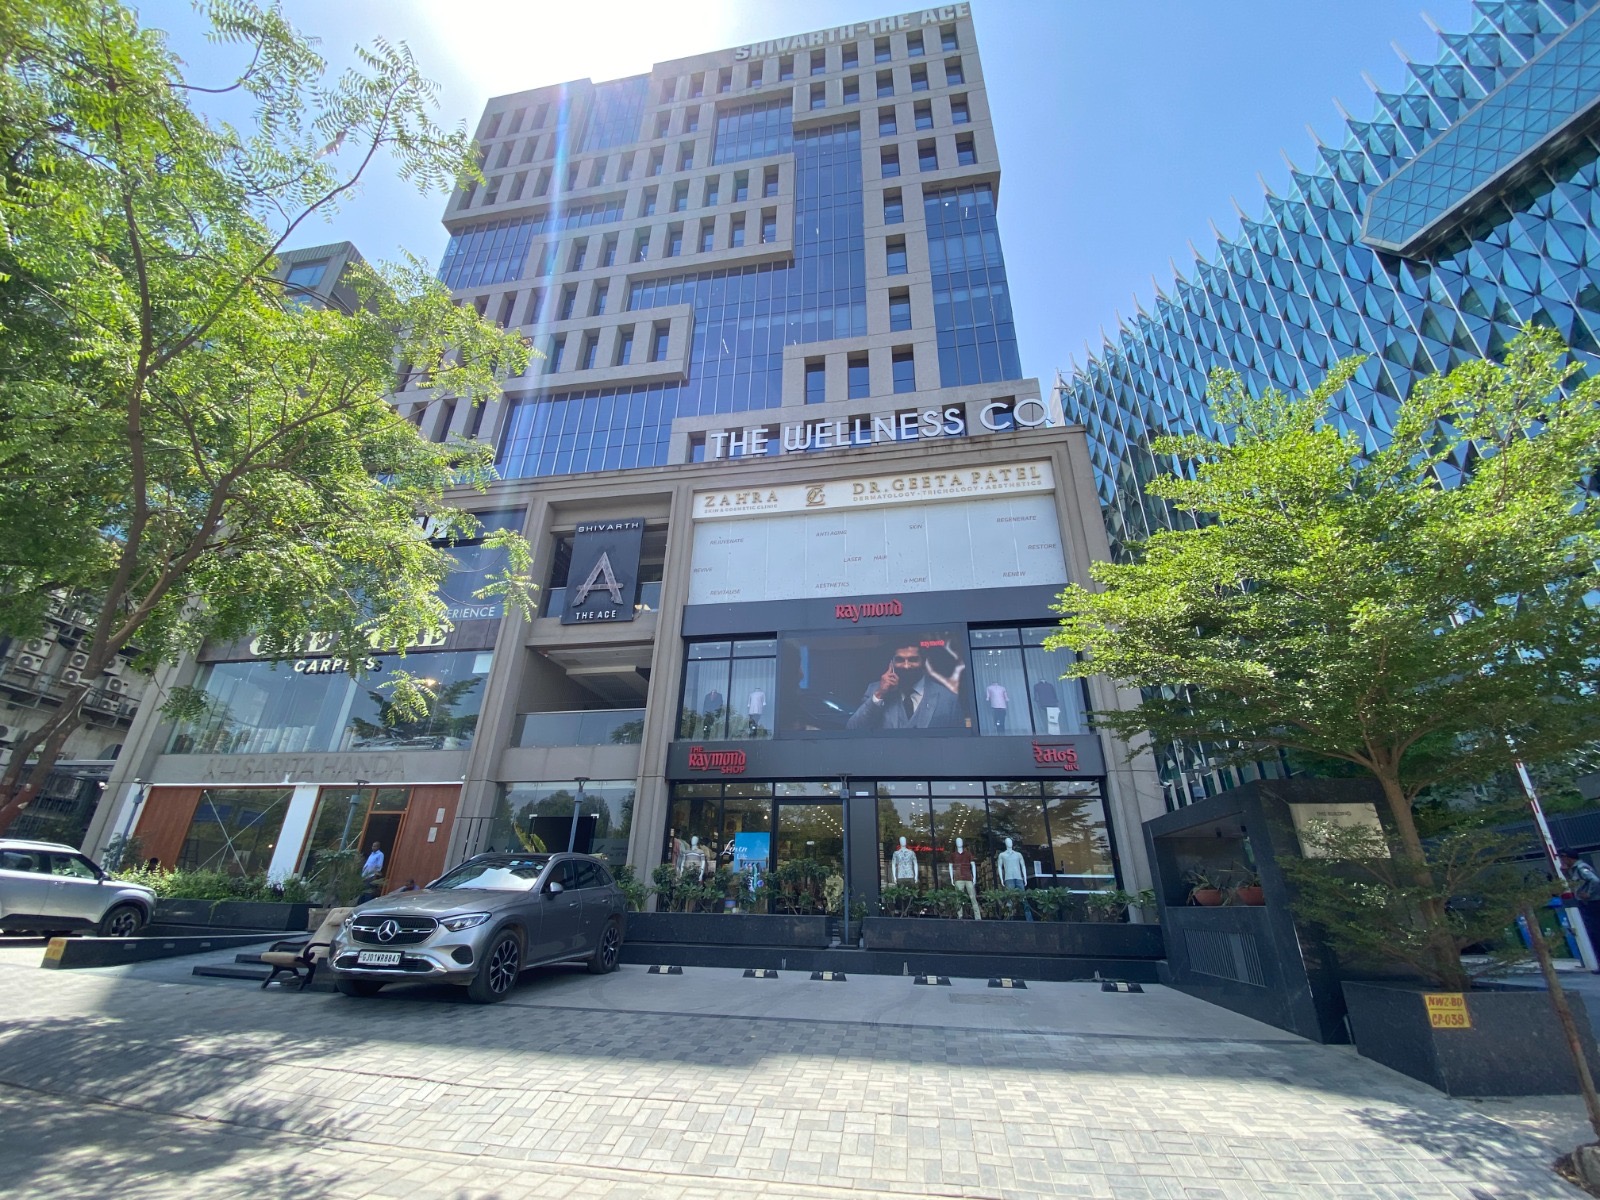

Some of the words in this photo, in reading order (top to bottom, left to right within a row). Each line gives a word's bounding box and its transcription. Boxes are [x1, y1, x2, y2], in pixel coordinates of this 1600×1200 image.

[920, 4, 969, 25] ACE
[711, 428, 768, 458] THE
[784, 408, 964, 451] WELLNESS
[853, 481, 888, 495] DR.
[892, 474, 962, 491] GEETA
[972, 466, 1041, 484] PATEL
[704, 490, 778, 508] ZAHRA
[853, 492, 915, 501] DERMATOLOGY
[922, 486, 978, 496] TRICHOLOGY
[986, 480, 1042, 489] AESTHETICS
[578, 522, 639, 533] SHIVARTH
[996, 515, 1037, 523] REGENERATE
[571, 551, 624, 607] A
[439, 606, 496, 619] PERIENCE
[575, 611, 594, 620] THE
[597, 609, 617, 619] ACE
[835, 599, 903, 623] Raymond
[294, 657, 375, 673] CARPES
[688, 749, 747, 771] Raymond
[721, 766, 746, 774] SHOP
